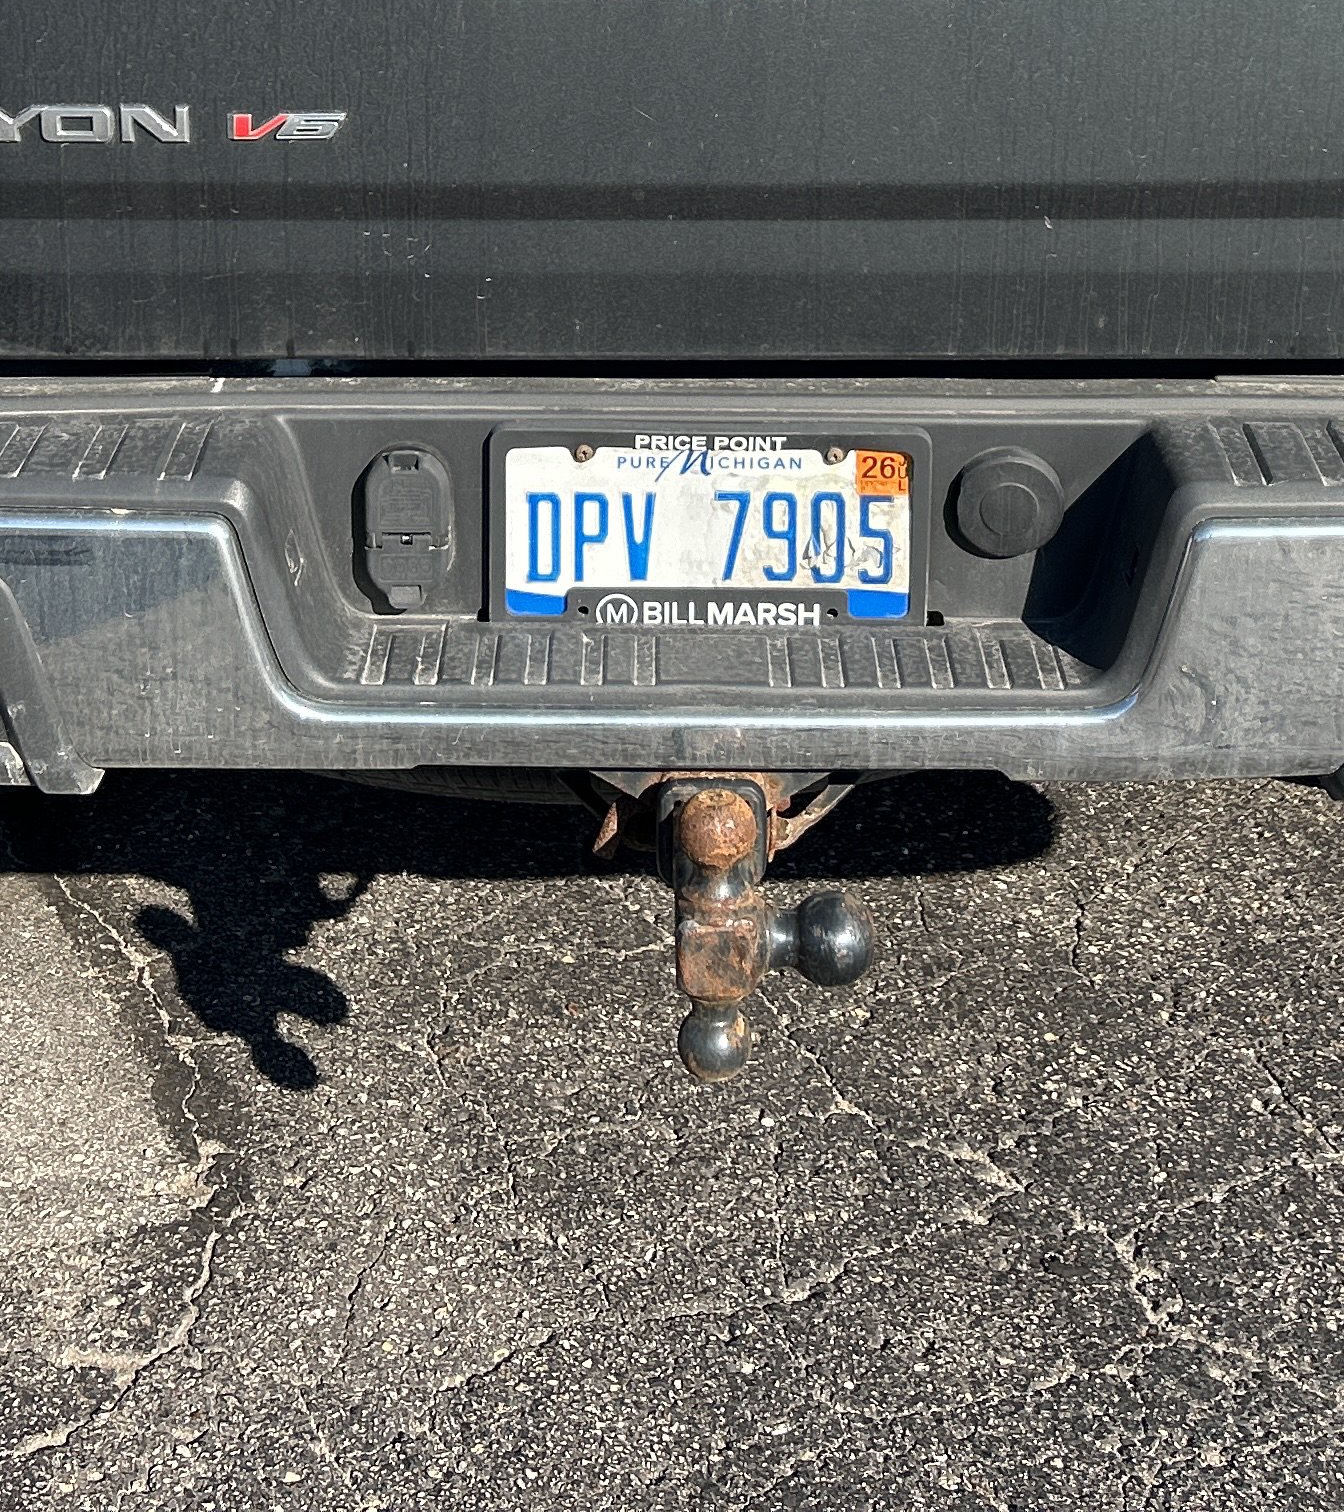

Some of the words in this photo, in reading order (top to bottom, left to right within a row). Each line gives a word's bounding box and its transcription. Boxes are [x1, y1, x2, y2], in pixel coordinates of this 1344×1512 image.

[227, 112, 347, 141] V6
[635, 434, 706, 451] PRICE
[714, 436, 787, 451] POINT
[617, 456, 670, 469] PURE
[655, 449, 802, 482] MICHIGAN
[861, 455, 896, 479] 26
[526, 491, 655, 583] DPV
[714, 490, 893, 583] 7905
[643, 601, 705, 624] BILL
[707, 602, 820, 625] MARSH
